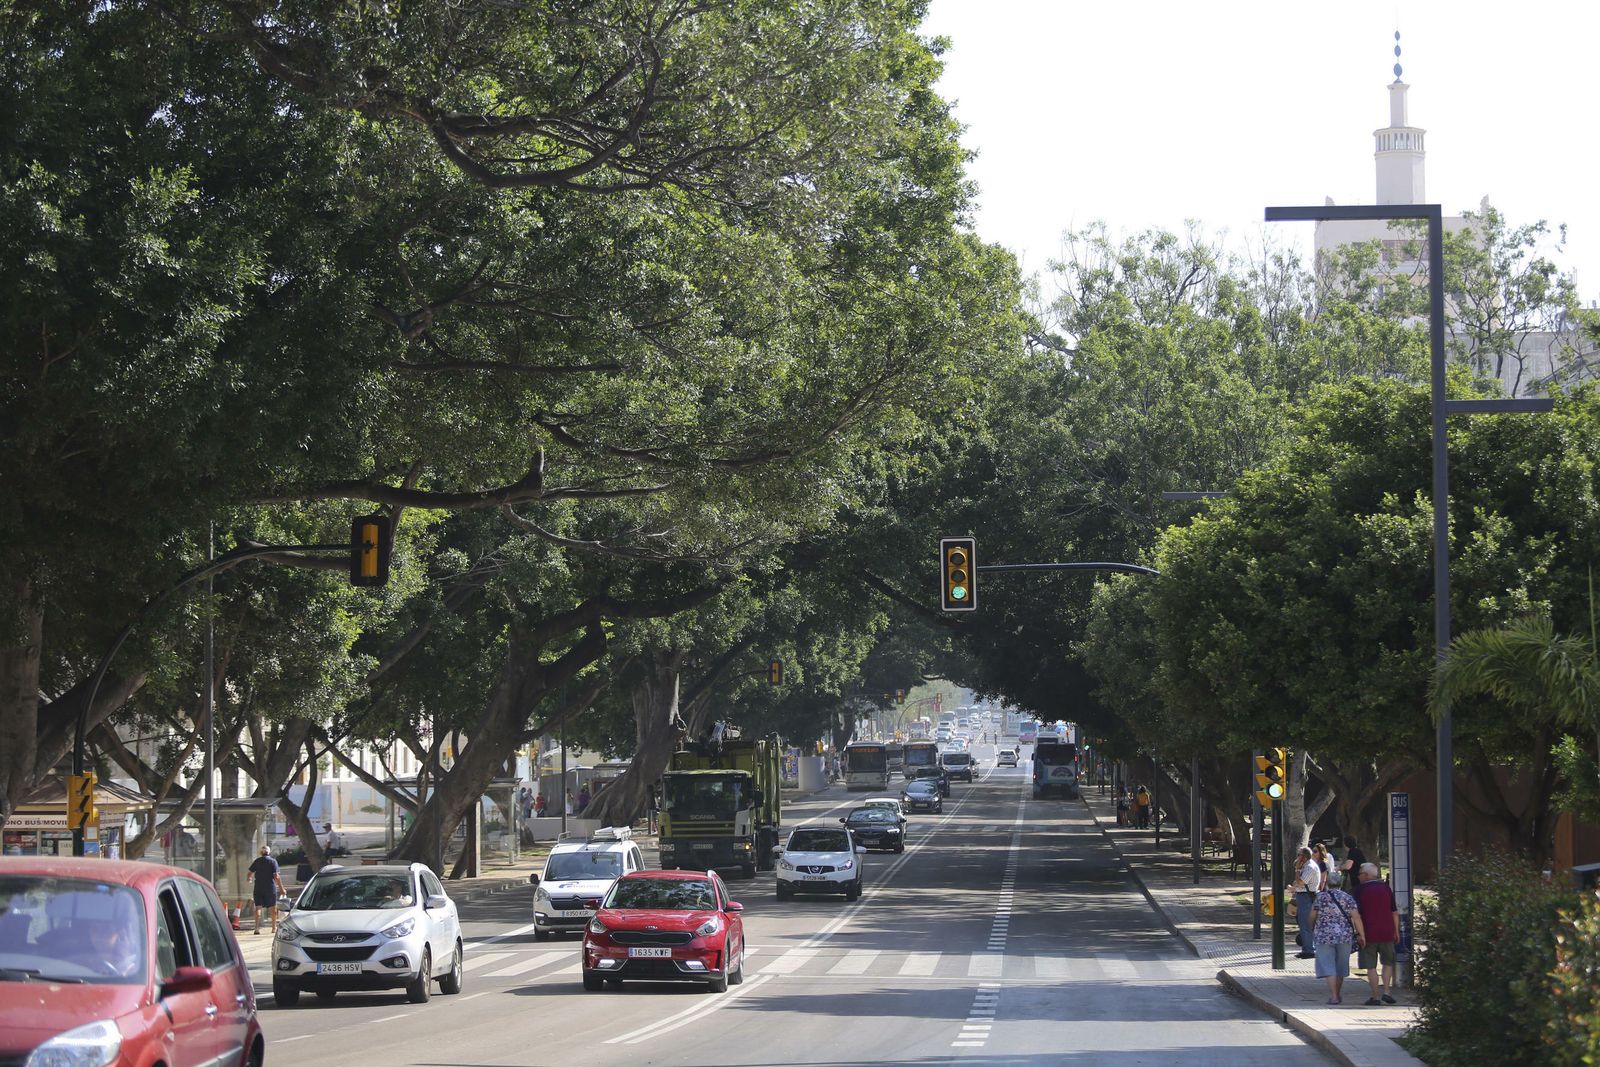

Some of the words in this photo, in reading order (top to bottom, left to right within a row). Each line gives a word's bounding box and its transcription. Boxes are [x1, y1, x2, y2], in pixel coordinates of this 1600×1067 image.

[1392, 796, 1407, 808] BUS
[322, 964, 343, 972] 2436
[344, 964, 360, 972] HSV
